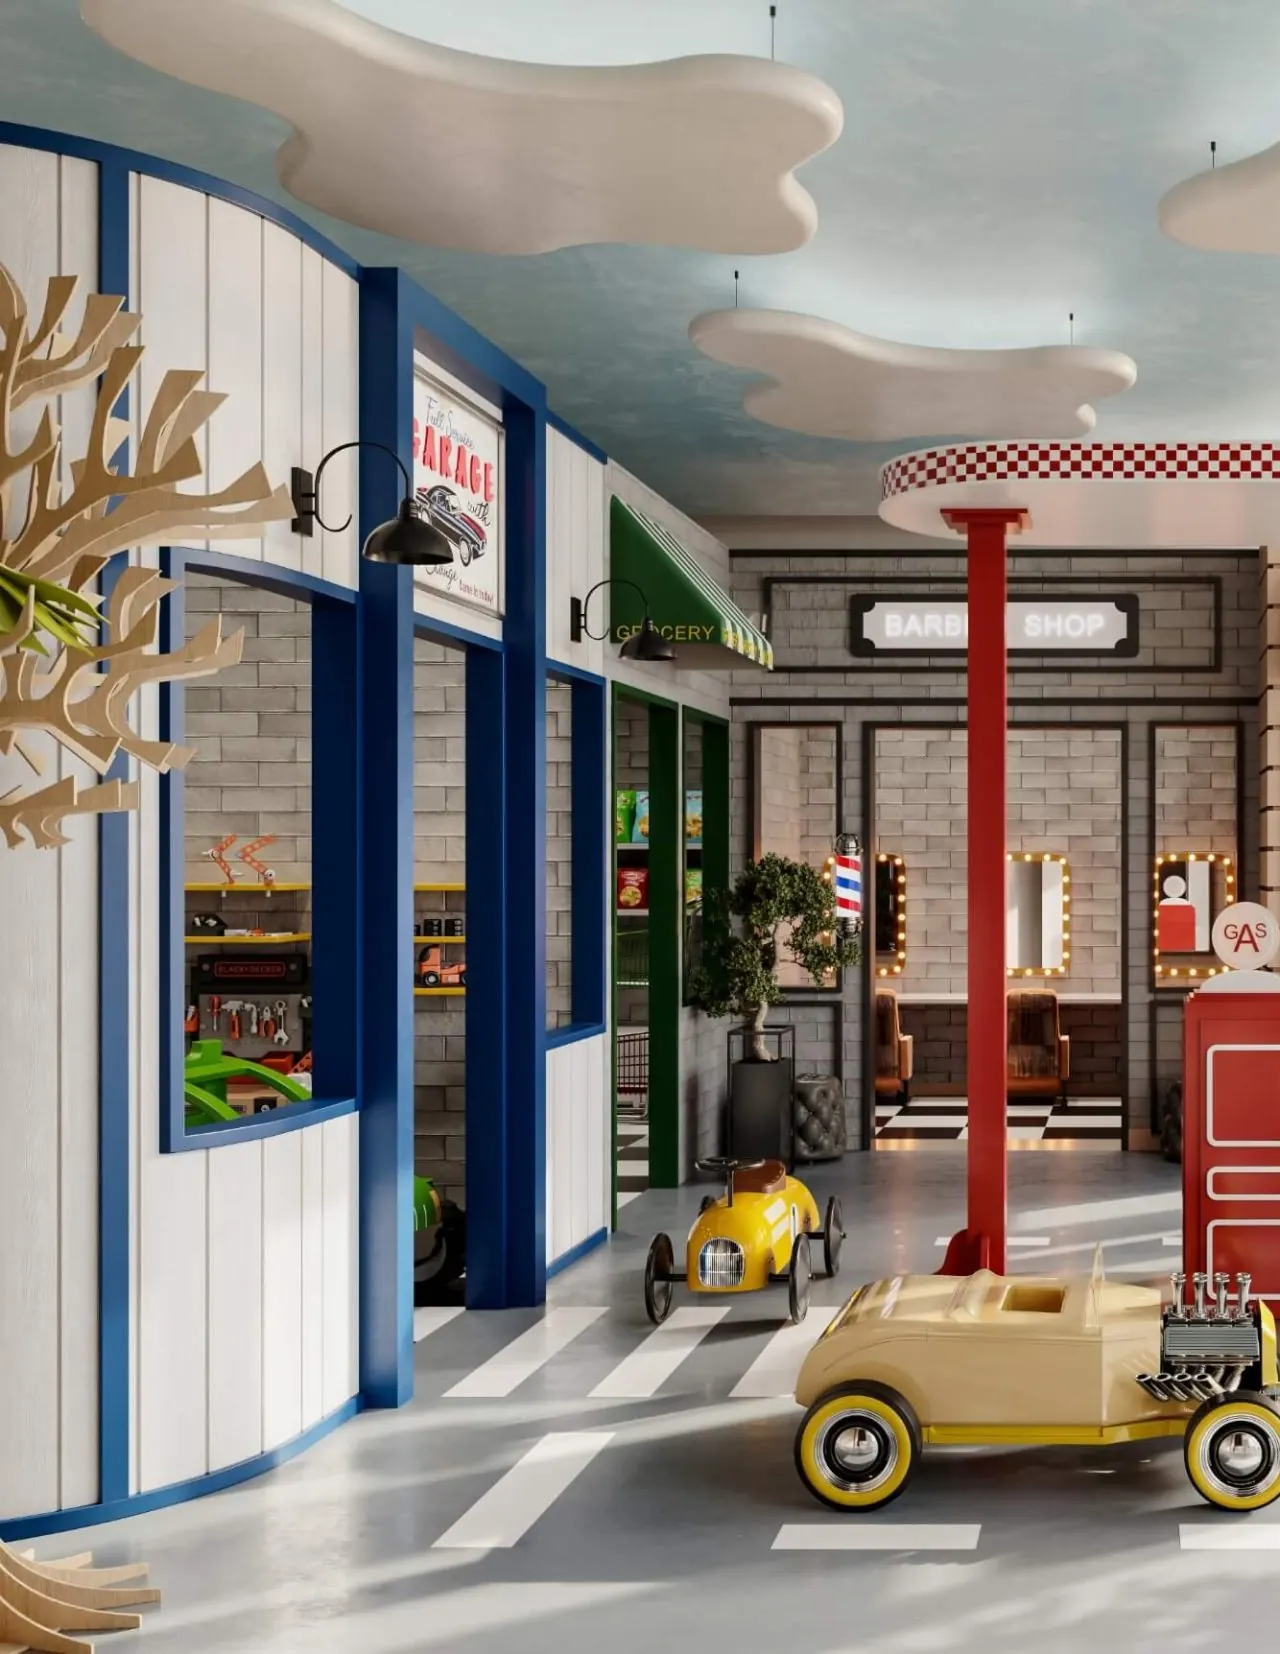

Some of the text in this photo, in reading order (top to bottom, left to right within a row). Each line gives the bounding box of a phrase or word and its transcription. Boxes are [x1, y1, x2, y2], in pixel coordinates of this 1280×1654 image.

[616, 625, 714, 641] GCERY
[884, 613, 1105, 638] BARB SHOP
[1224, 922, 1267, 953] GAS
